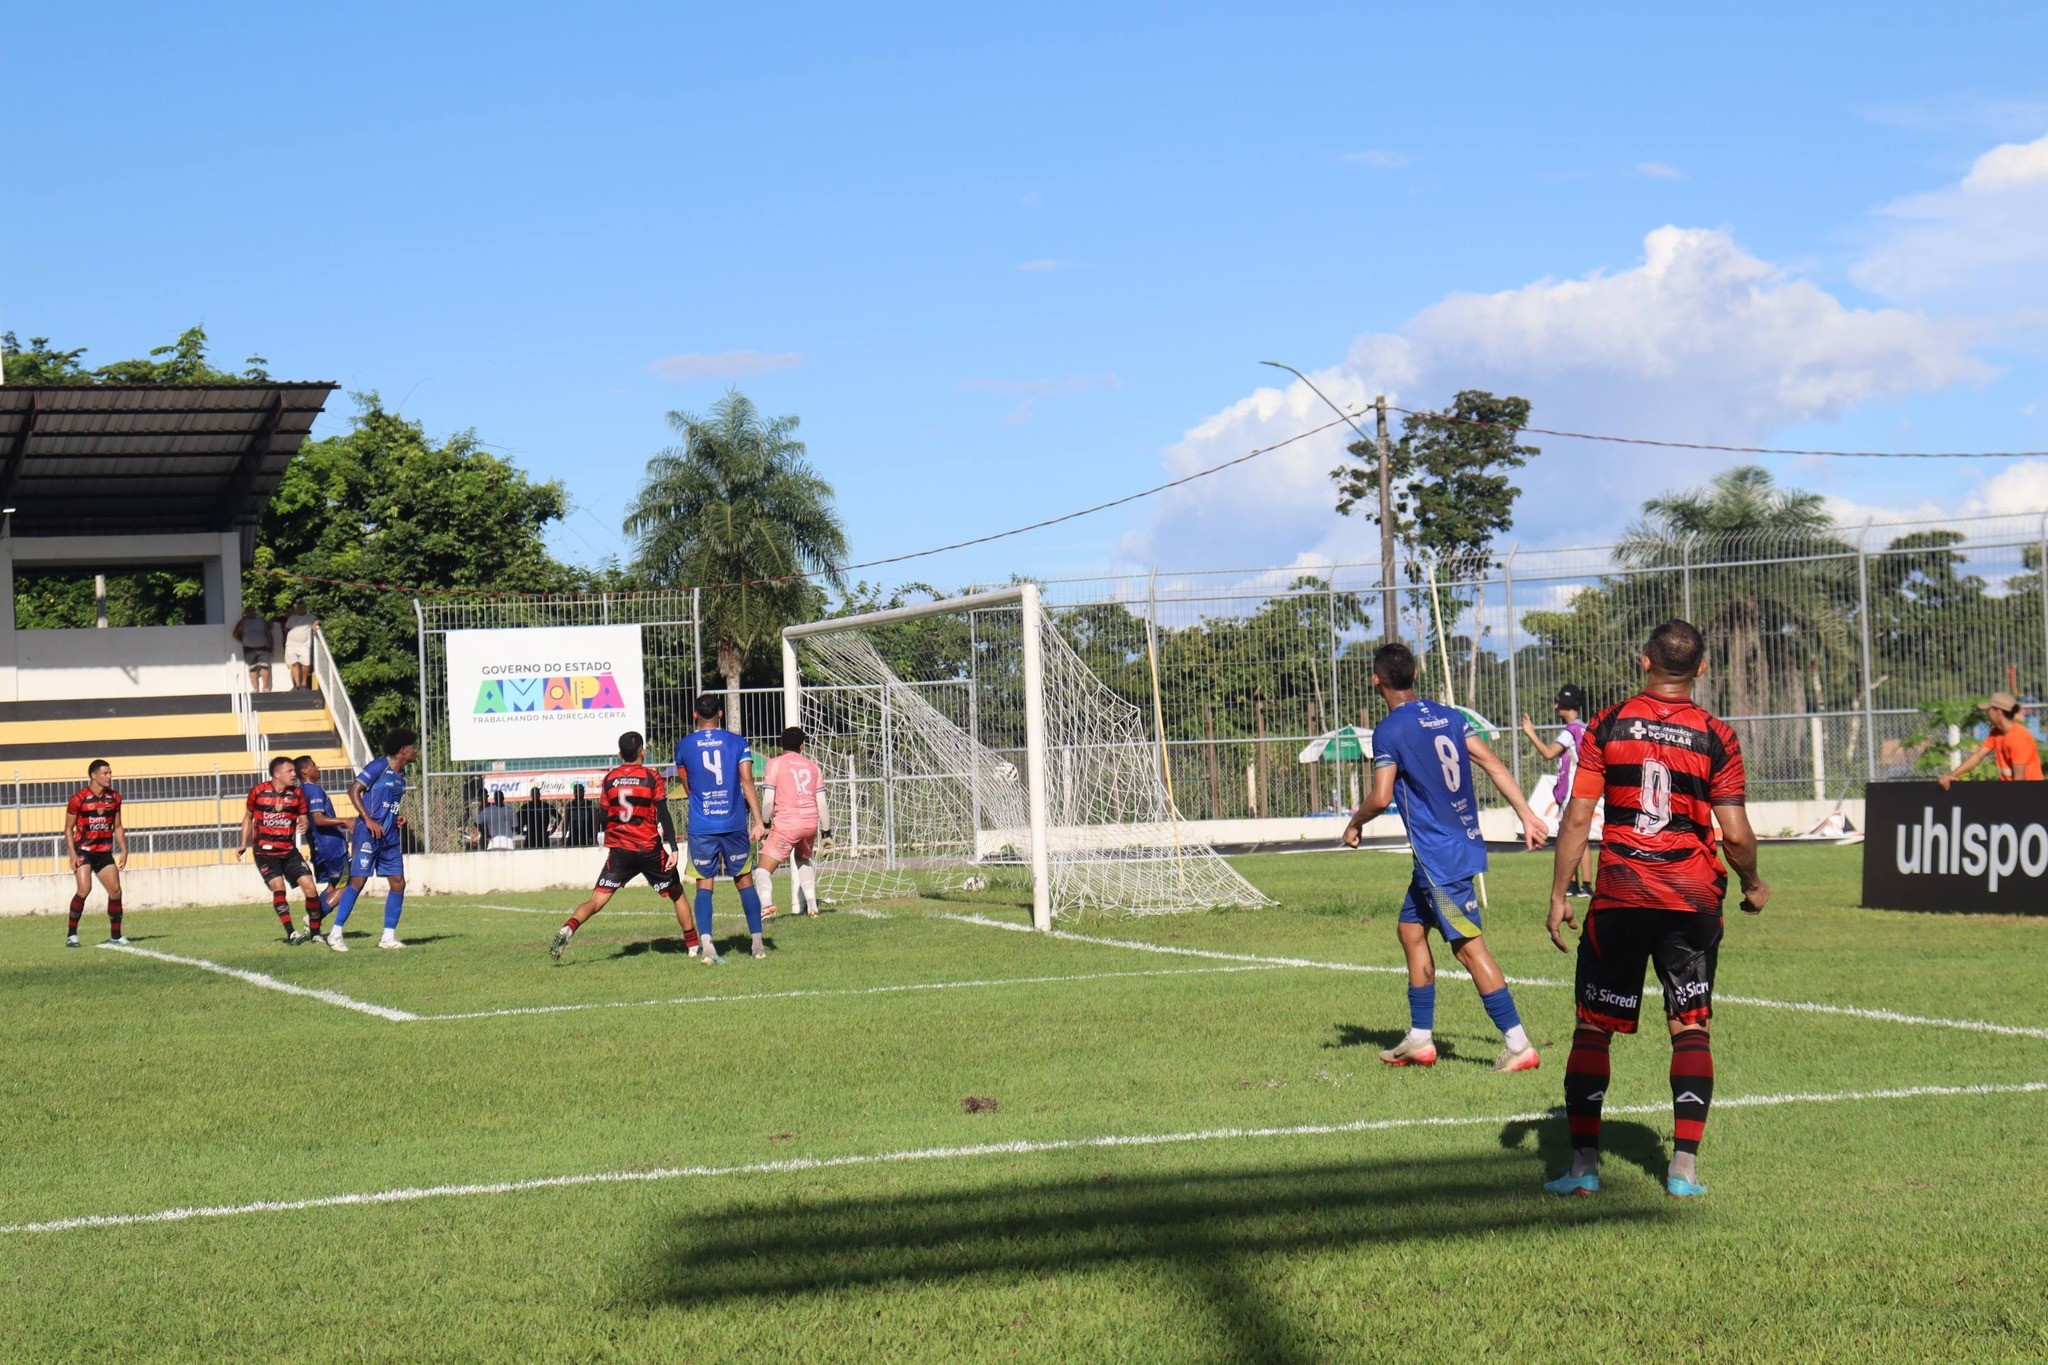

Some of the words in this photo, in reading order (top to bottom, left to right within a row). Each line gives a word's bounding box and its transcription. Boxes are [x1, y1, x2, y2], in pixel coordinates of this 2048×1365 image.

[481, 664, 541, 675] GOVERNO
[544, 663, 562, 673] DO
[565, 661, 612, 671] ESTADO
[473, 714, 540, 724] TRABALHANDO
[557, 712, 596, 721] DIREÇÃO
[598, 711, 626, 719] CERTA
[1647, 730, 1692, 747] POPULAR
[702, 749, 723, 786] 4
[1434, 734, 1461, 793] 8
[790, 767, 813, 796] 12
[1633, 757, 1673, 835] 9
[618, 788, 634, 823] 5
[1896, 806, 2048, 893] uhlspo
[1598, 989, 1638, 1009] Sicredi
